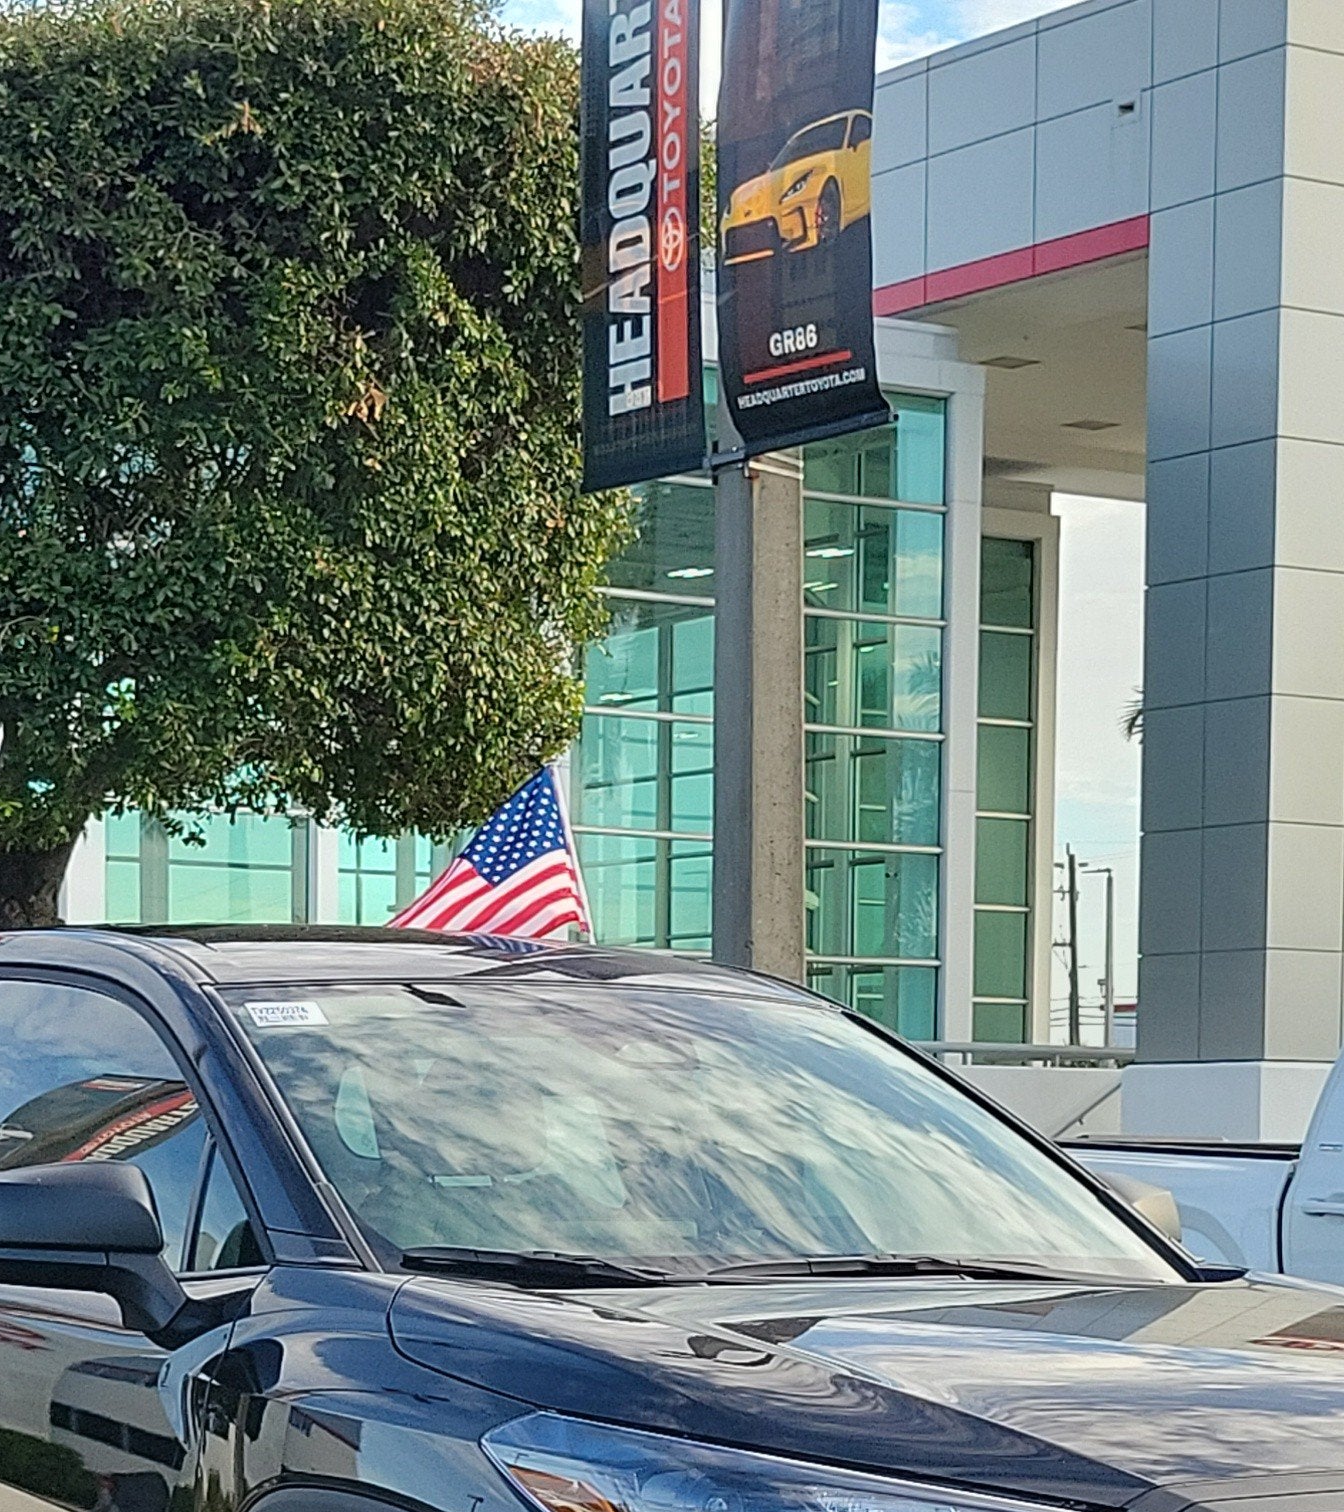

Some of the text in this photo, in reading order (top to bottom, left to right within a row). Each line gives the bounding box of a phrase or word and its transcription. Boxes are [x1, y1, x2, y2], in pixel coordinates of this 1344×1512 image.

[608, 0, 656, 416] HEADQUAR
[768, 323, 818, 357] GR86
[737, 367, 866, 410] HEADQUARTERTOYOTA.COM
